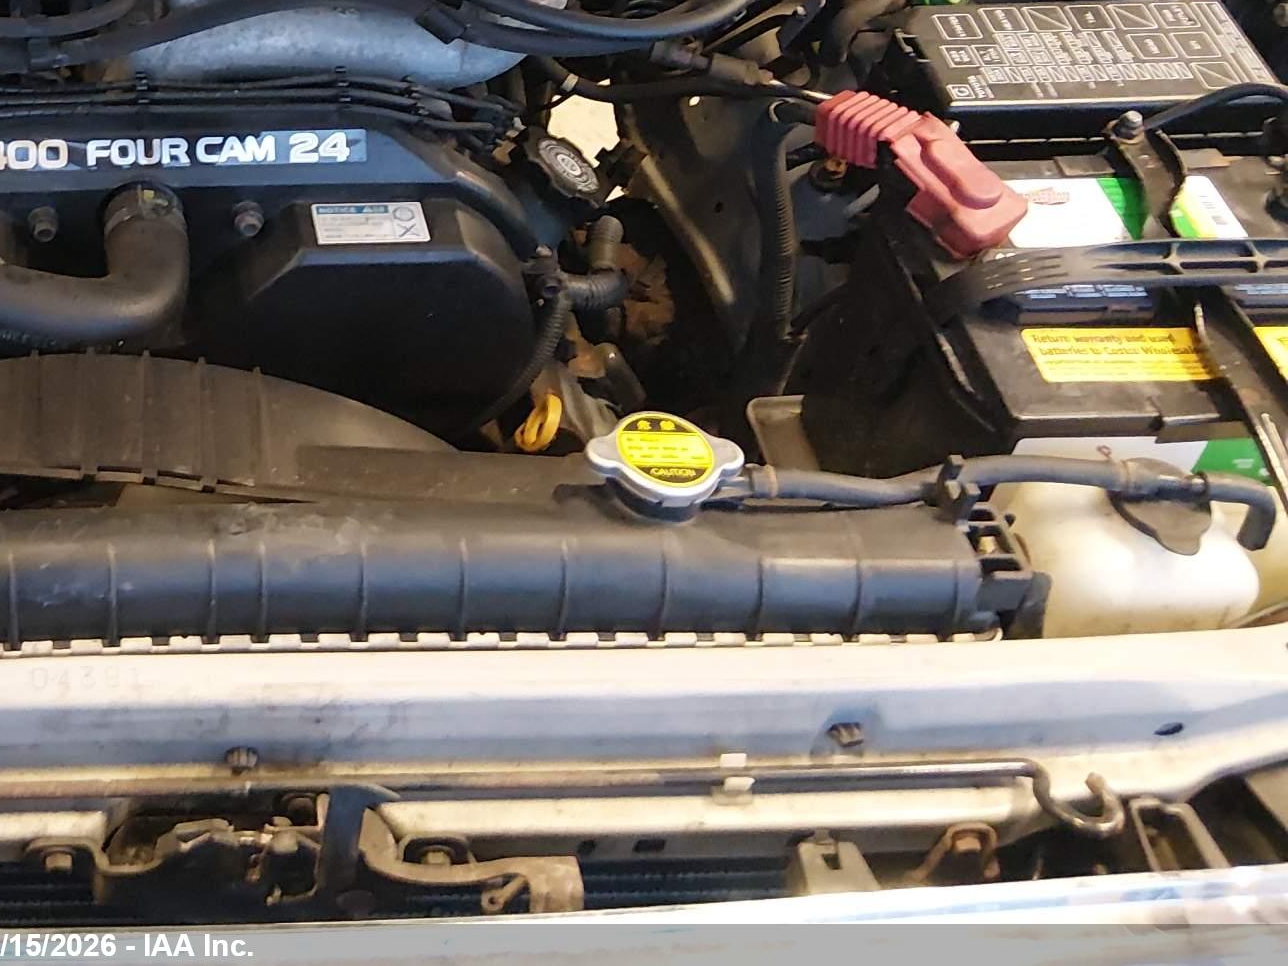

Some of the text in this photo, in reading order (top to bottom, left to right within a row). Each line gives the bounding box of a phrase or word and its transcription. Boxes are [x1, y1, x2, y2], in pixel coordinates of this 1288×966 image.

[85, 136, 191, 167] FOUR
[196, 134, 276, 164] CAM
[288, 131, 351, 164] 24
[1074, 335, 1123, 345] warranty
[1125, 334, 1145, 343] and
[1039, 347, 1089, 355] batteries
[650, 467, 697, 477] CAUTION
